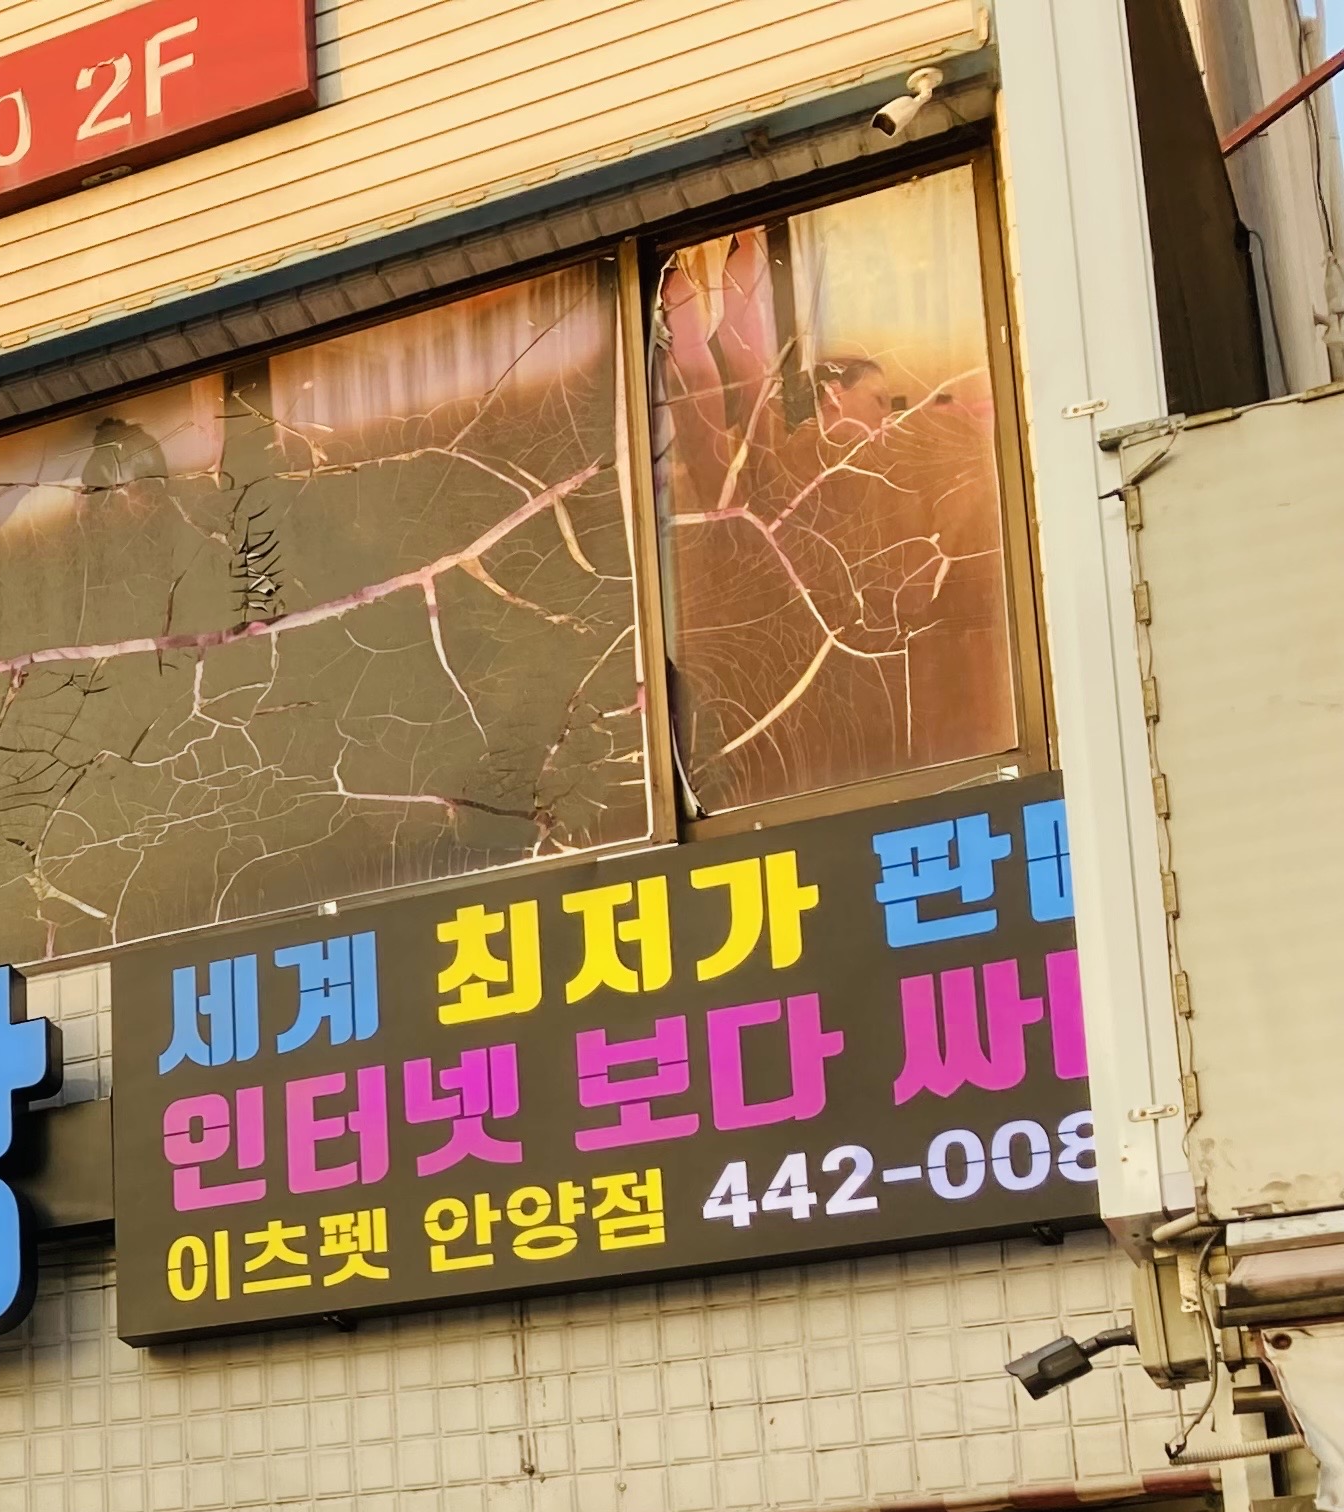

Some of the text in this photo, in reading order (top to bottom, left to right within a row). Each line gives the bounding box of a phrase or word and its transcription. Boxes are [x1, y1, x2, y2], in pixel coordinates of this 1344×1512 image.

[75, 16, 199, 141] 2F
[158, 930, 380, 1078] 세계
[435, 848, 821, 1027] 최저가
[161, 1041, 522, 1213] 인터넷
[574, 991, 845, 1155] 보다
[167, 1203, 391, 1305] 이츠펫
[423, 1168, 666, 1275] 안양점
